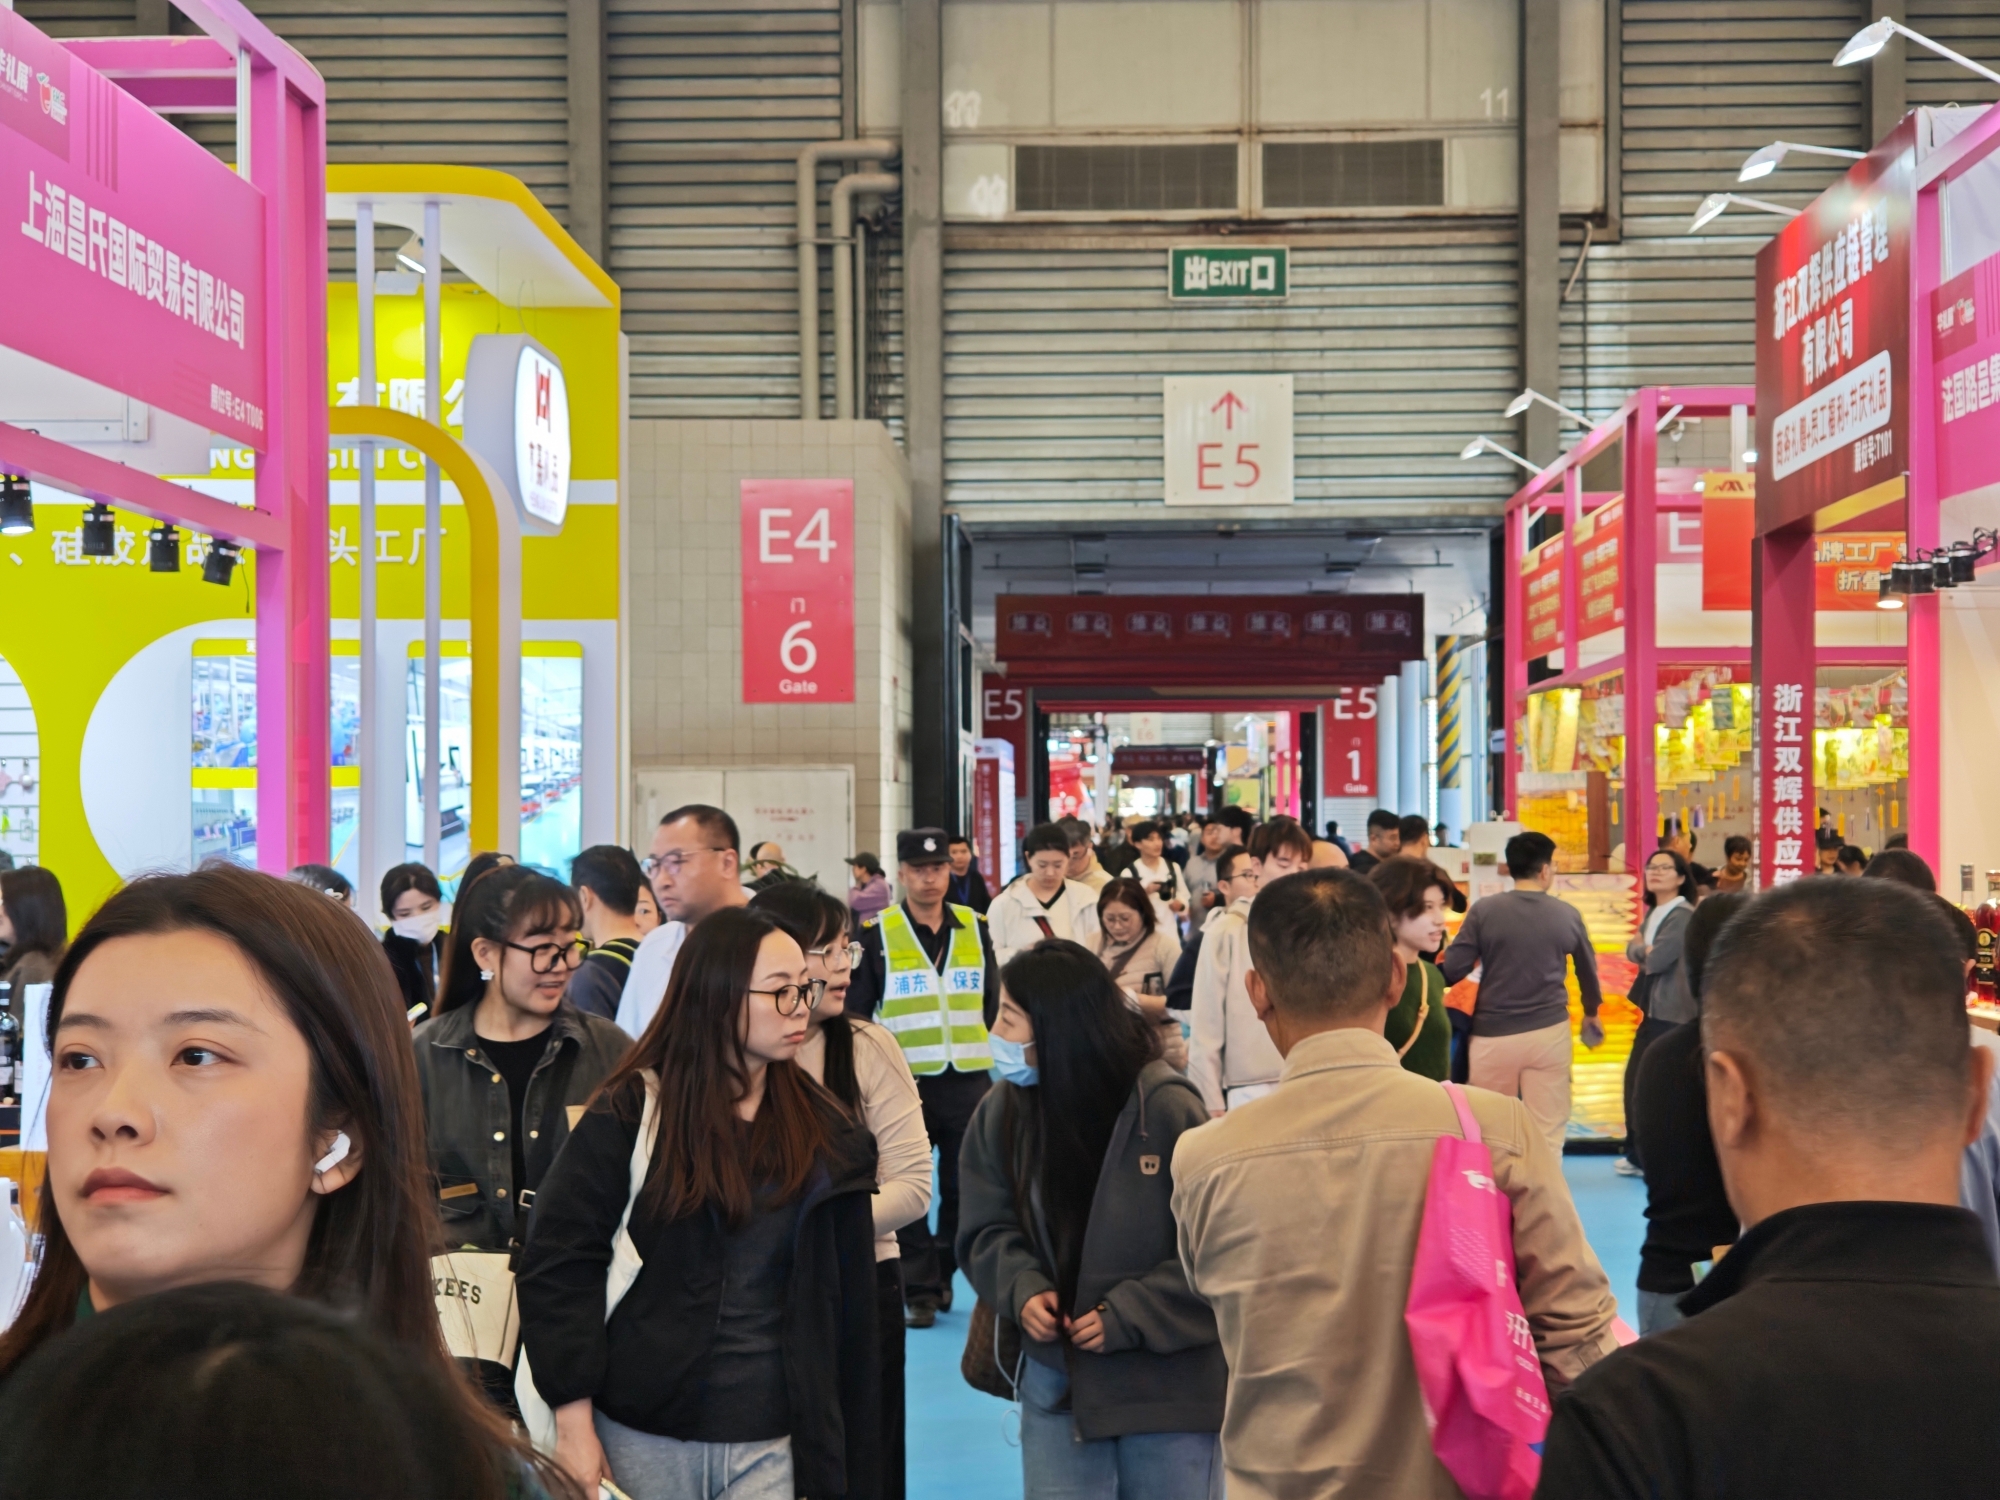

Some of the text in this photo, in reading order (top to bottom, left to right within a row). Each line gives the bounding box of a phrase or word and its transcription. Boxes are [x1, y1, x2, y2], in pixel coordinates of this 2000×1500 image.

[21, 170, 245, 350] 上海昌氏国际贸易有限公司
[1773, 197, 1889, 341] 浙江双辉供应链管理
[1802, 297, 1853, 387] 有限公司
[1197, 443, 1262, 490] E5
[759, 508, 837, 563] E4
[1815, 541, 1891, 562] 牌工厂
[780, 620, 817, 674] 6
[779, 679, 818, 694] Gate
[984, 689, 1023, 720] E5
[1333, 688, 1377, 720] E5
[1346, 750, 1361, 781] 1
[1344, 783, 1368, 794] Gate
[894, 970, 980, 995] 浦东 保安
